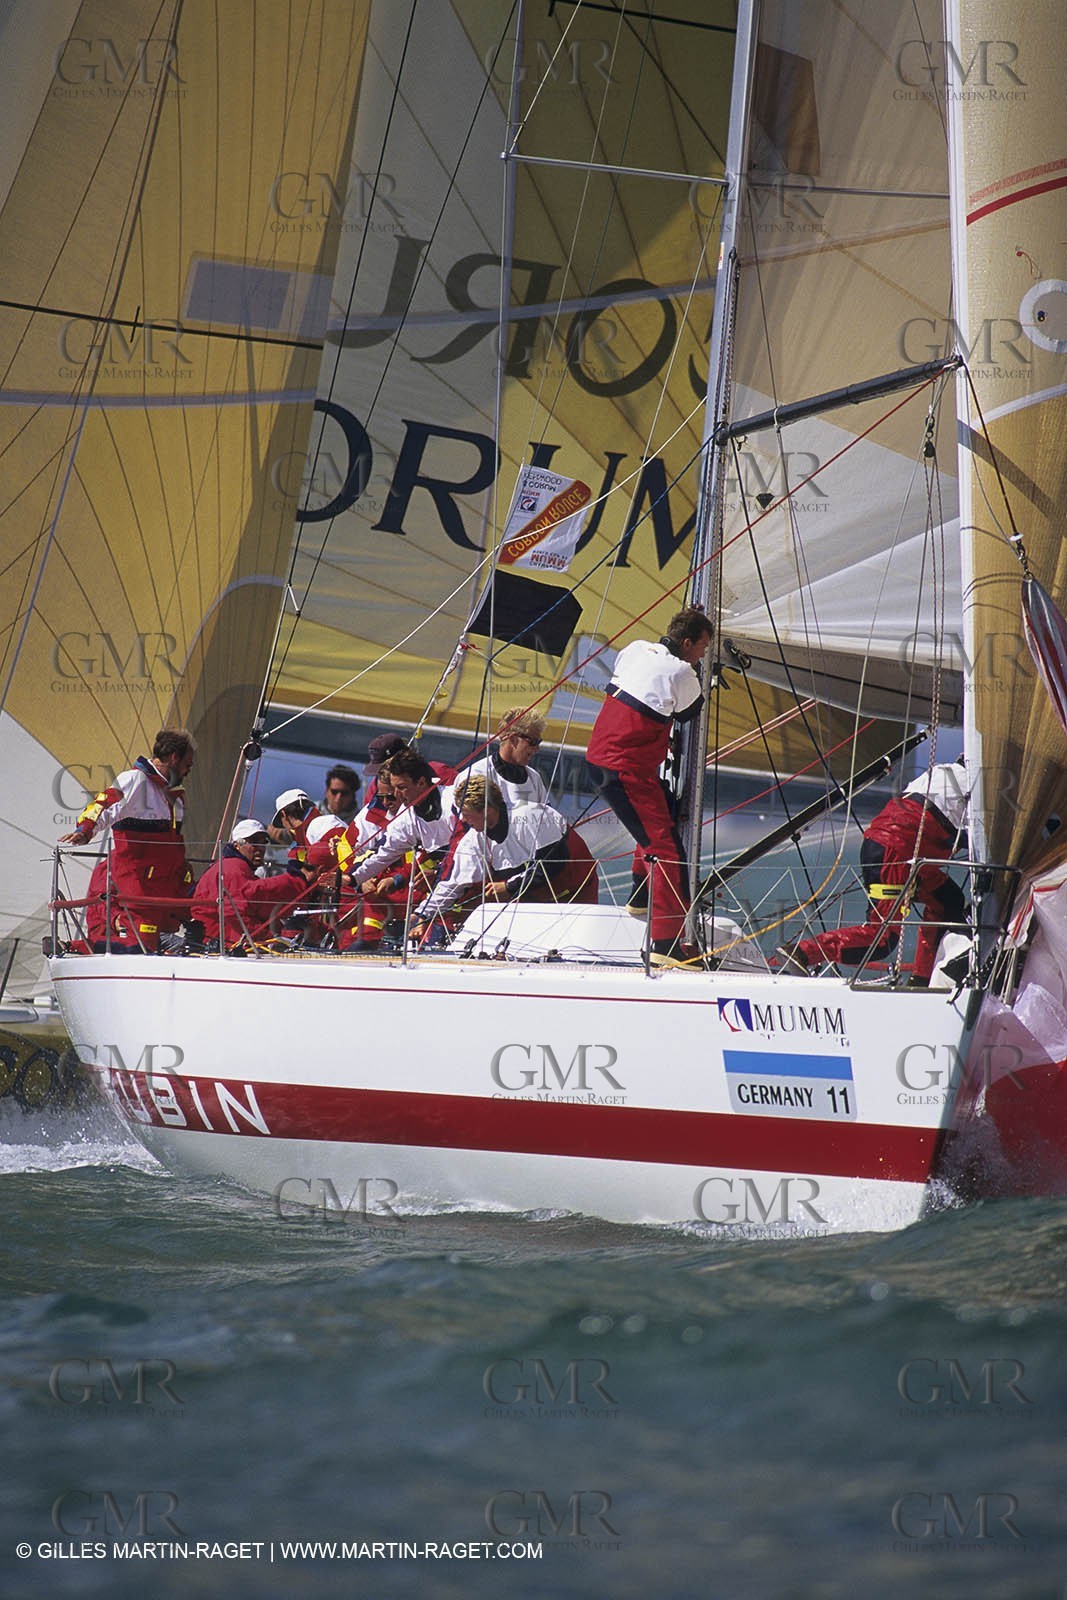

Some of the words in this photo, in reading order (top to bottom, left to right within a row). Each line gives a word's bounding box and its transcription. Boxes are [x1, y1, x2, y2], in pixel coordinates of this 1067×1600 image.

[753, 1004, 846, 1035] MUMM
[737, 1083, 813, 1108] GERMANY
[827, 1086, 850, 1114] 11
